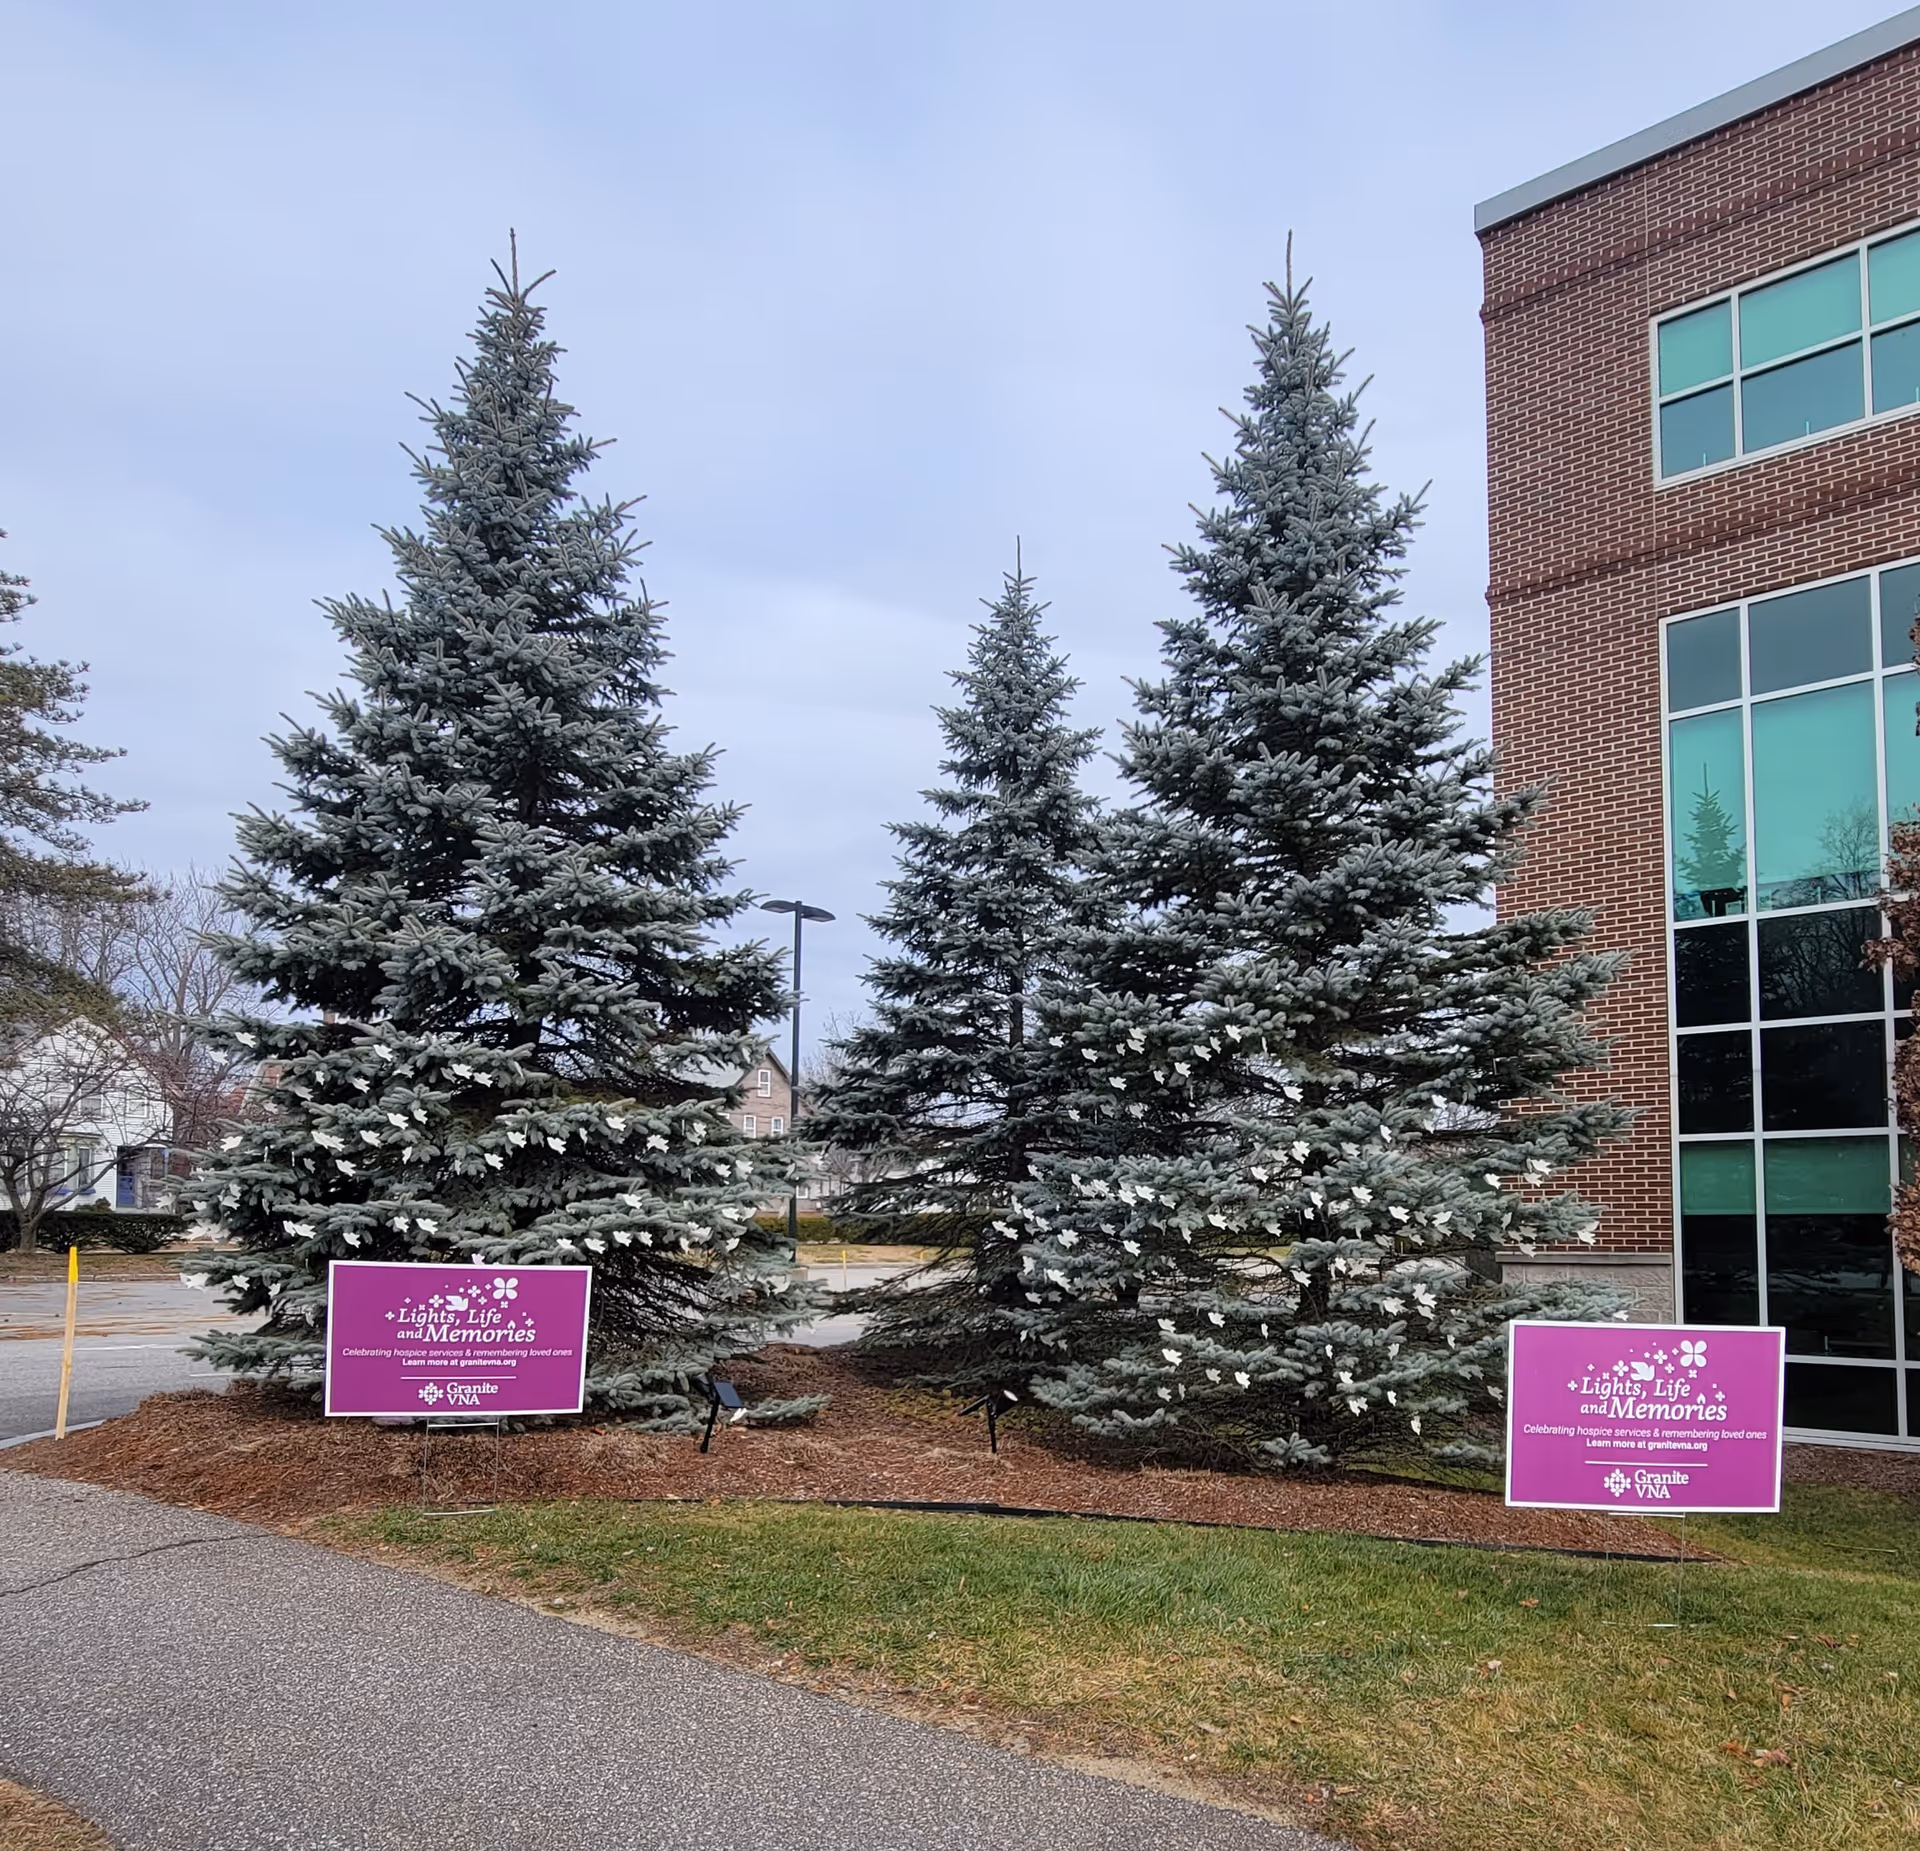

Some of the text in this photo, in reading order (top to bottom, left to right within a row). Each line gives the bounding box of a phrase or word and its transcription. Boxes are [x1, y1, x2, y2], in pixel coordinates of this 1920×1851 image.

[397, 1308, 501, 1327] Lights, Life
[397, 1321, 536, 1342] and Memories
[343, 1348, 391, 1357] Celebrating
[394, 1349, 427, 1357] hospice
[473, 1349, 527, 1357] remembering
[460, 1359, 516, 1367] granitevna.org
[447, 1383, 498, 1394] Granite
[1580, 1377, 1690, 1401] Lights, Life
[447, 1394, 480, 1405] VNA
[1581, 1393, 1727, 1420] and Memories
[1524, 1424, 1575, 1436] Celebrating
[1577, 1426, 1612, 1438] hospice
[1615, 1428, 1651, 1437] services
[1653, 1428, 1660, 1437] &
[1662, 1429, 1719, 1440] remembering
[1721, 1430, 1744, 1439] loved
[1587, 1439, 1708, 1451] Learn more at granitevna.org
[1634, 1470, 1689, 1485] Granite
[1635, 1485, 1671, 1499] VNA
